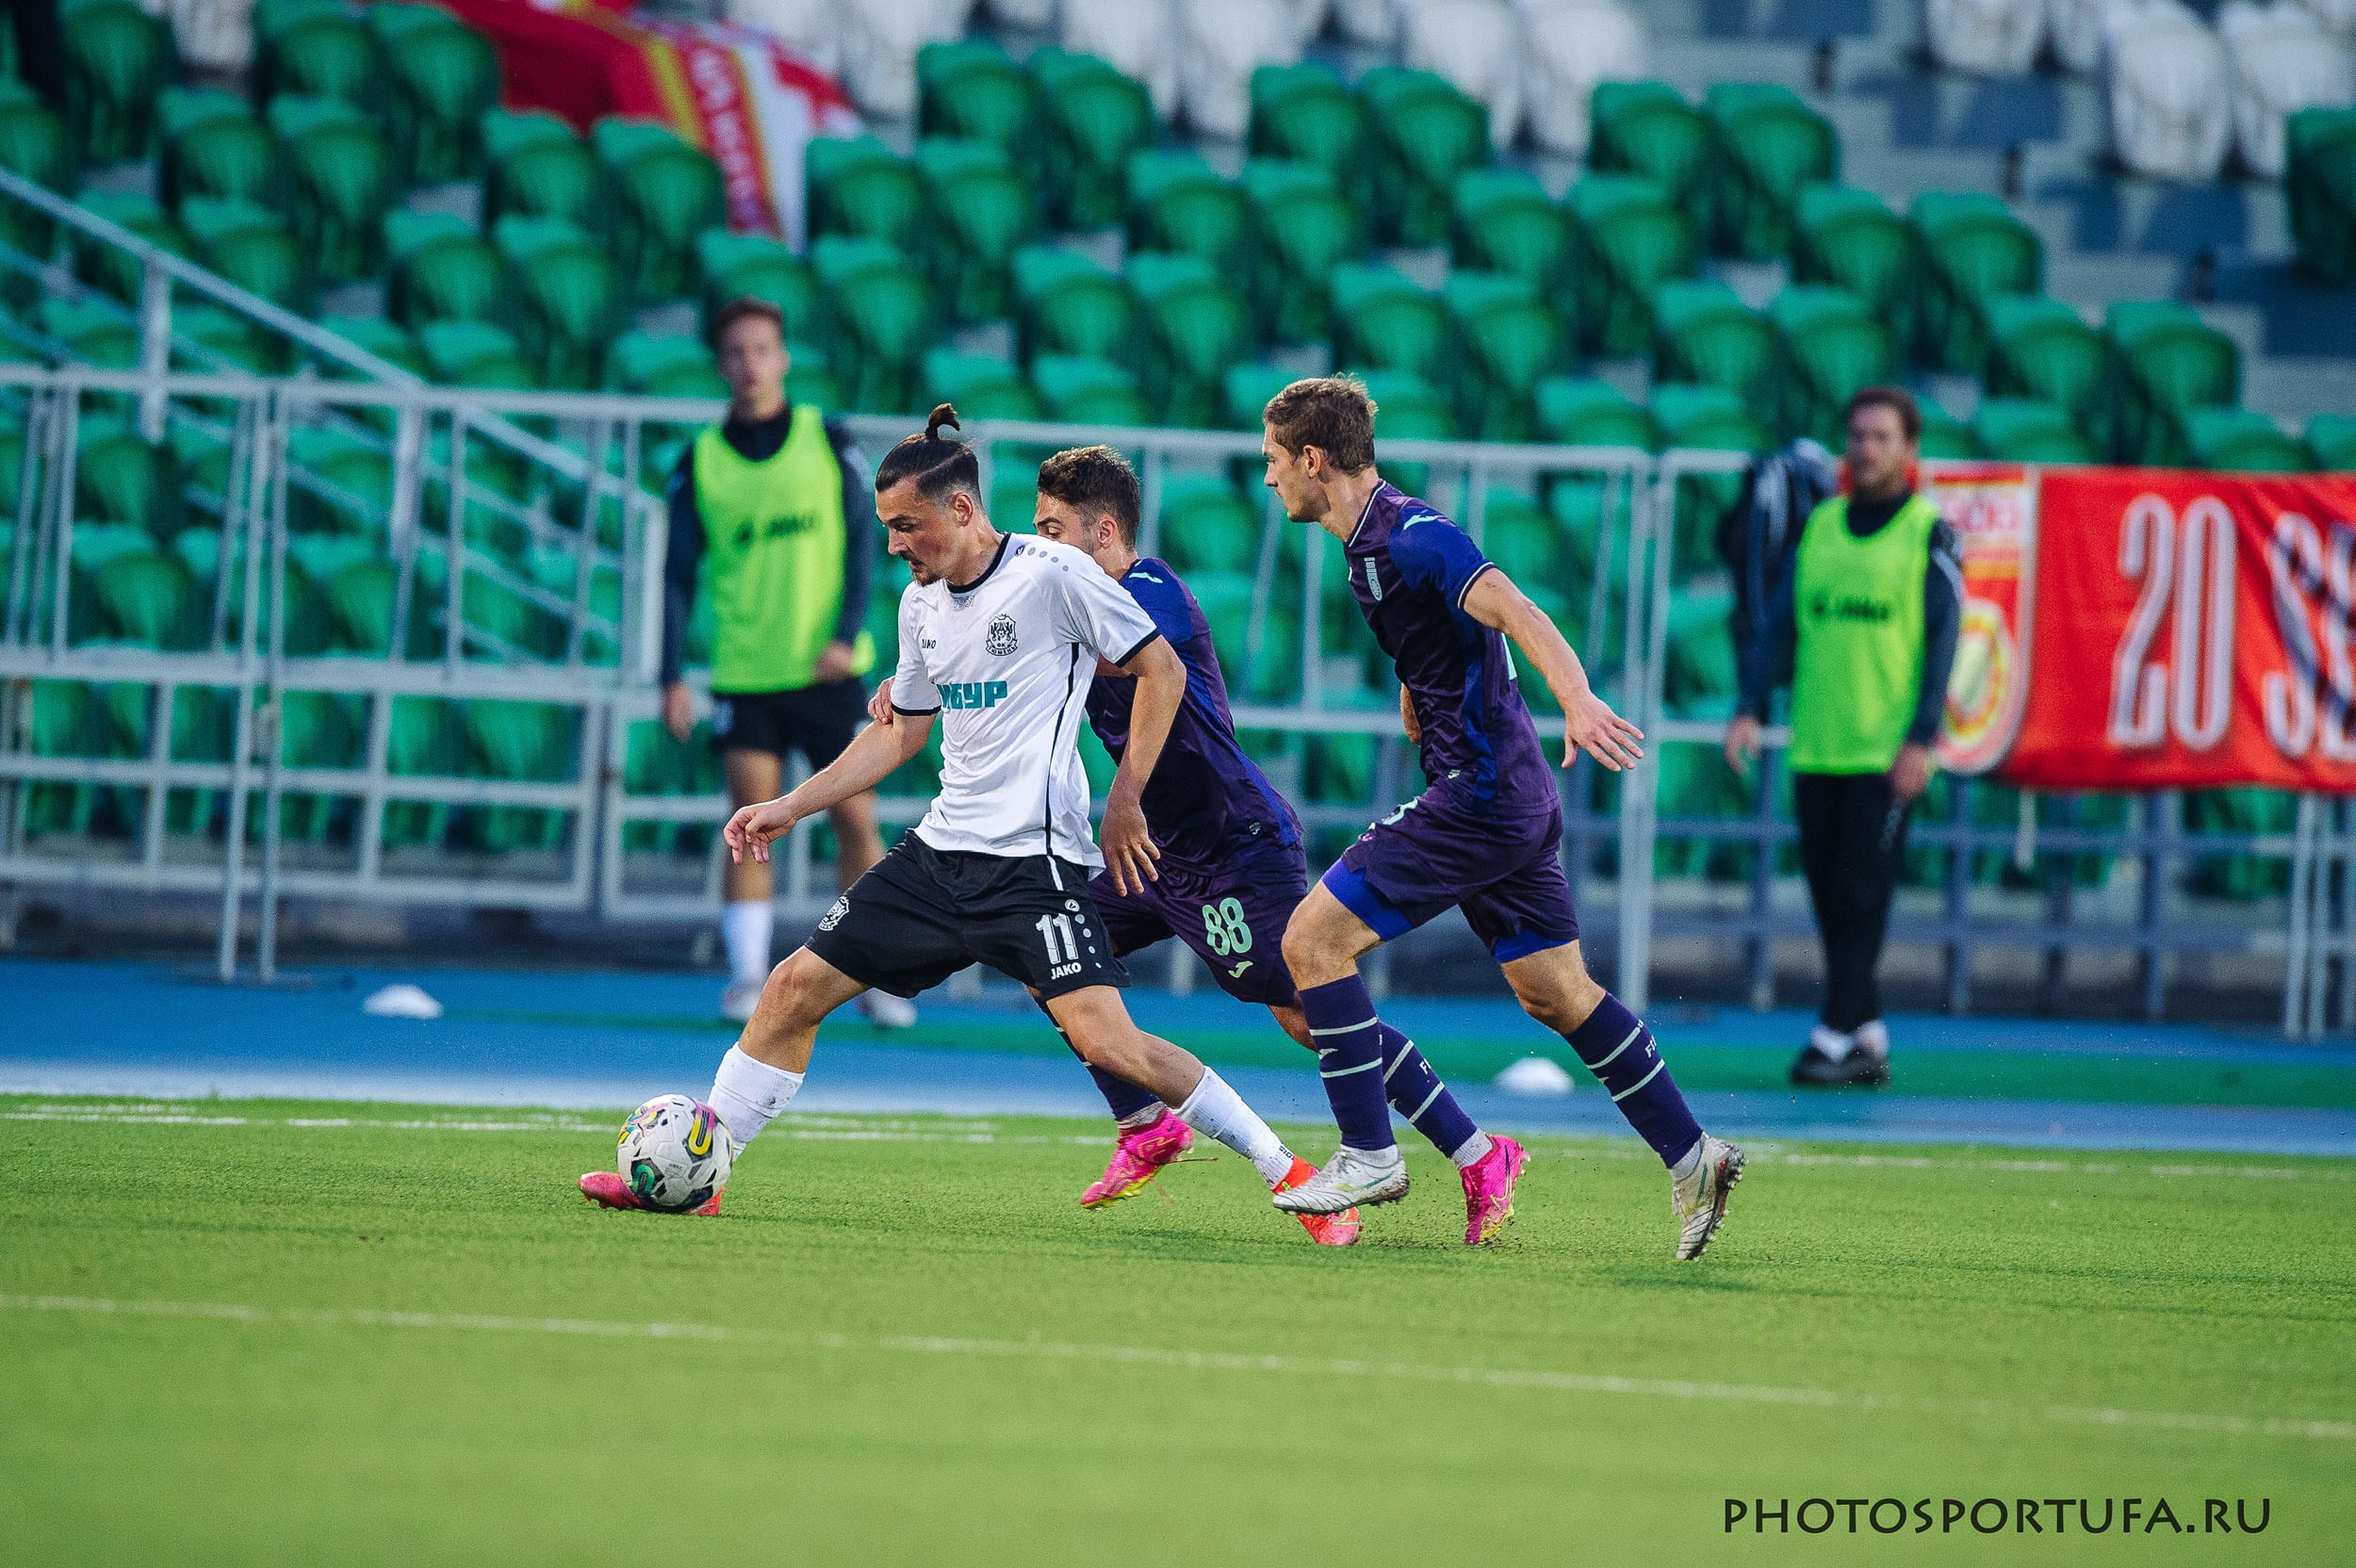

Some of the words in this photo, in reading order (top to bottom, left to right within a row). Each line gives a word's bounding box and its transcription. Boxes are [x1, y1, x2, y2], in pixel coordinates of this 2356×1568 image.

[2107, 492, 2237, 752] 20
[1035, 912, 1079, 965] 11
[1202, 896, 1253, 956] 88
[1051, 961, 1083, 980] JAKO
